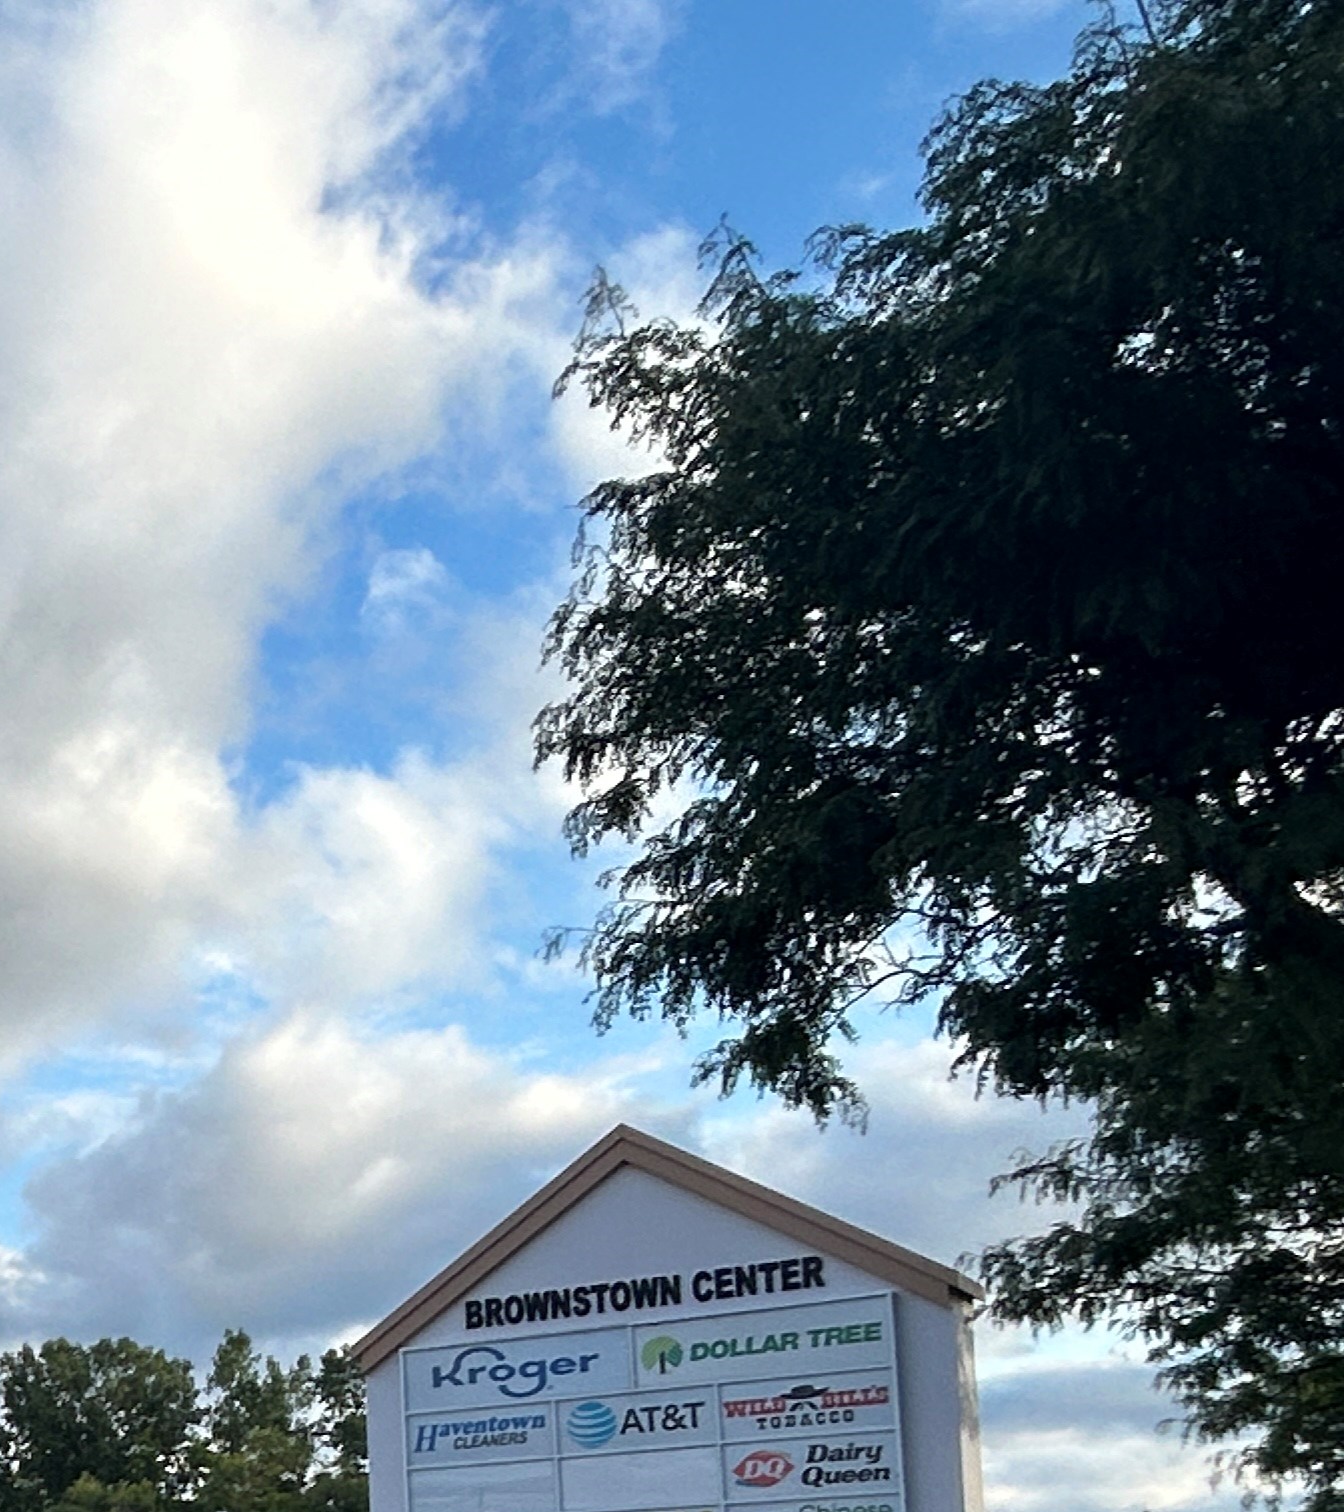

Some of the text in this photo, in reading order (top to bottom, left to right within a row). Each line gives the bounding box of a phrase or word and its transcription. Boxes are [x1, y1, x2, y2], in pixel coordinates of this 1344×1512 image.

[465, 1256, 826, 1330] BROWNSTOWN CENTER
[690, 1321, 883, 1362] DOLLAR TREE
[432, 1346, 600, 1398] Kroger
[620, 1401, 706, 1435] AT&T
[756, 1409, 855, 1430] TOBACCO
[414, 1414, 546, 1451] Haventown
[453, 1431, 528, 1450] CLEANERS
[806, 1443, 883, 1464] Dairy
[744, 1458, 786, 1480] DQ
[801, 1466, 891, 1488] Queen
